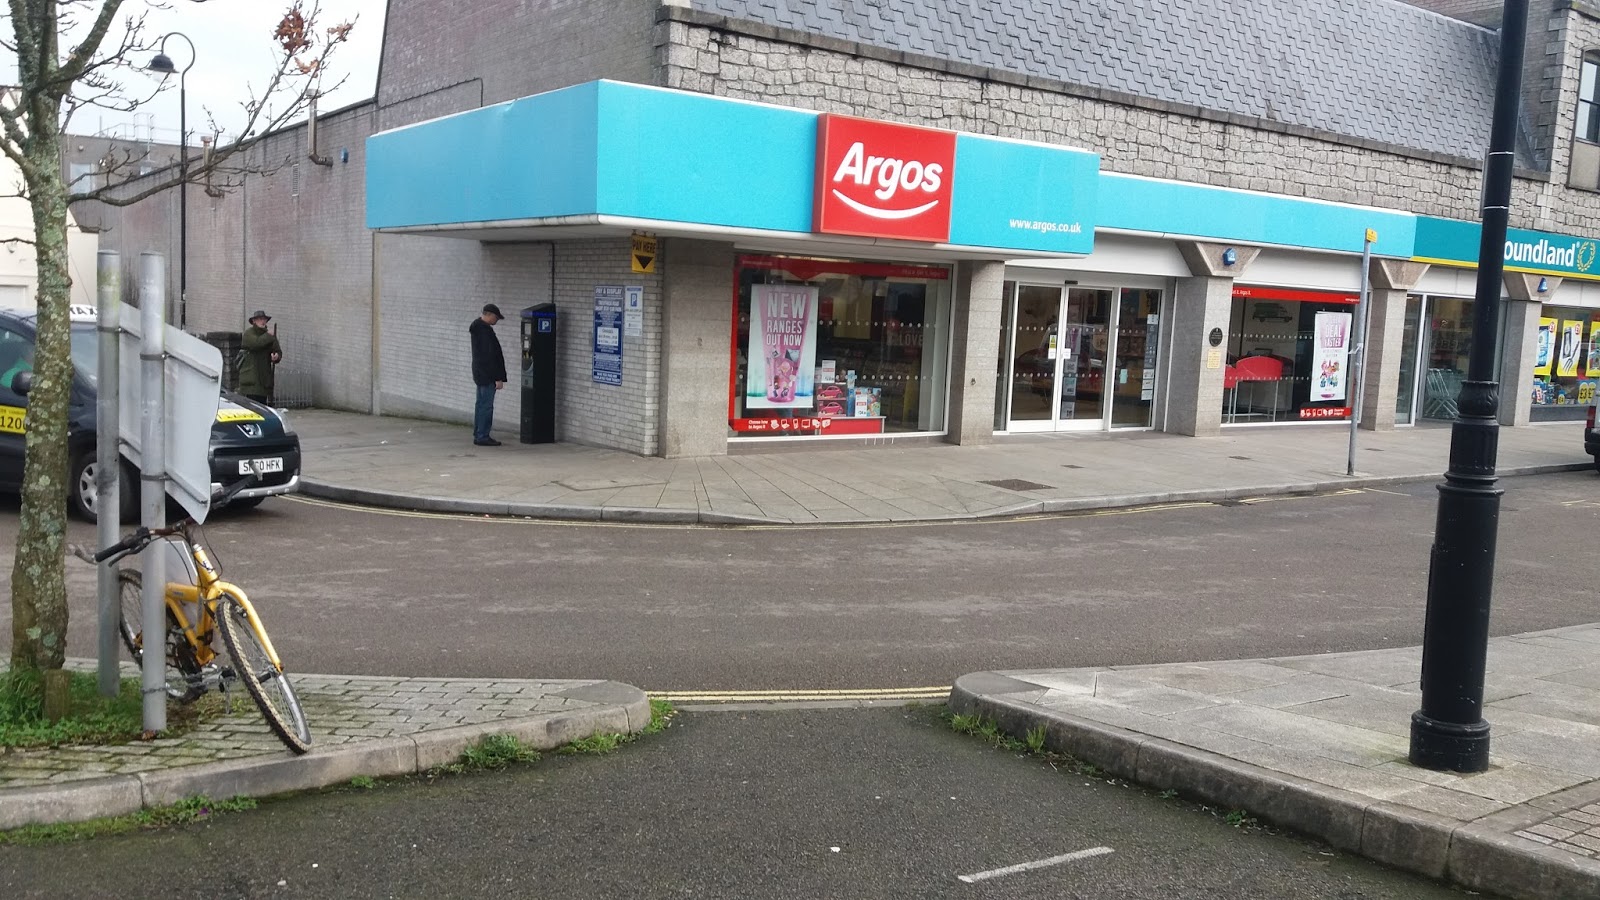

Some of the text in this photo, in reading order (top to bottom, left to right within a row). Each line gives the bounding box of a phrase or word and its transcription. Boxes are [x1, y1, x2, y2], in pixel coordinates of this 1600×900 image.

[833, 141, 944, 200] Argos
[1009, 218, 1082, 234] www.argos.co.uk
[632, 239, 656, 253] PAY HERE
[1503, 238, 1576, 267] oundland
[70, 306, 97, 316] TAX
[767, 292, 807, 319] NEW
[541, 320, 550, 330] P
[766, 319, 803, 334] RANGES
[766, 333, 802, 346] OUT NOW
[266, 459, 280, 471] HFK
